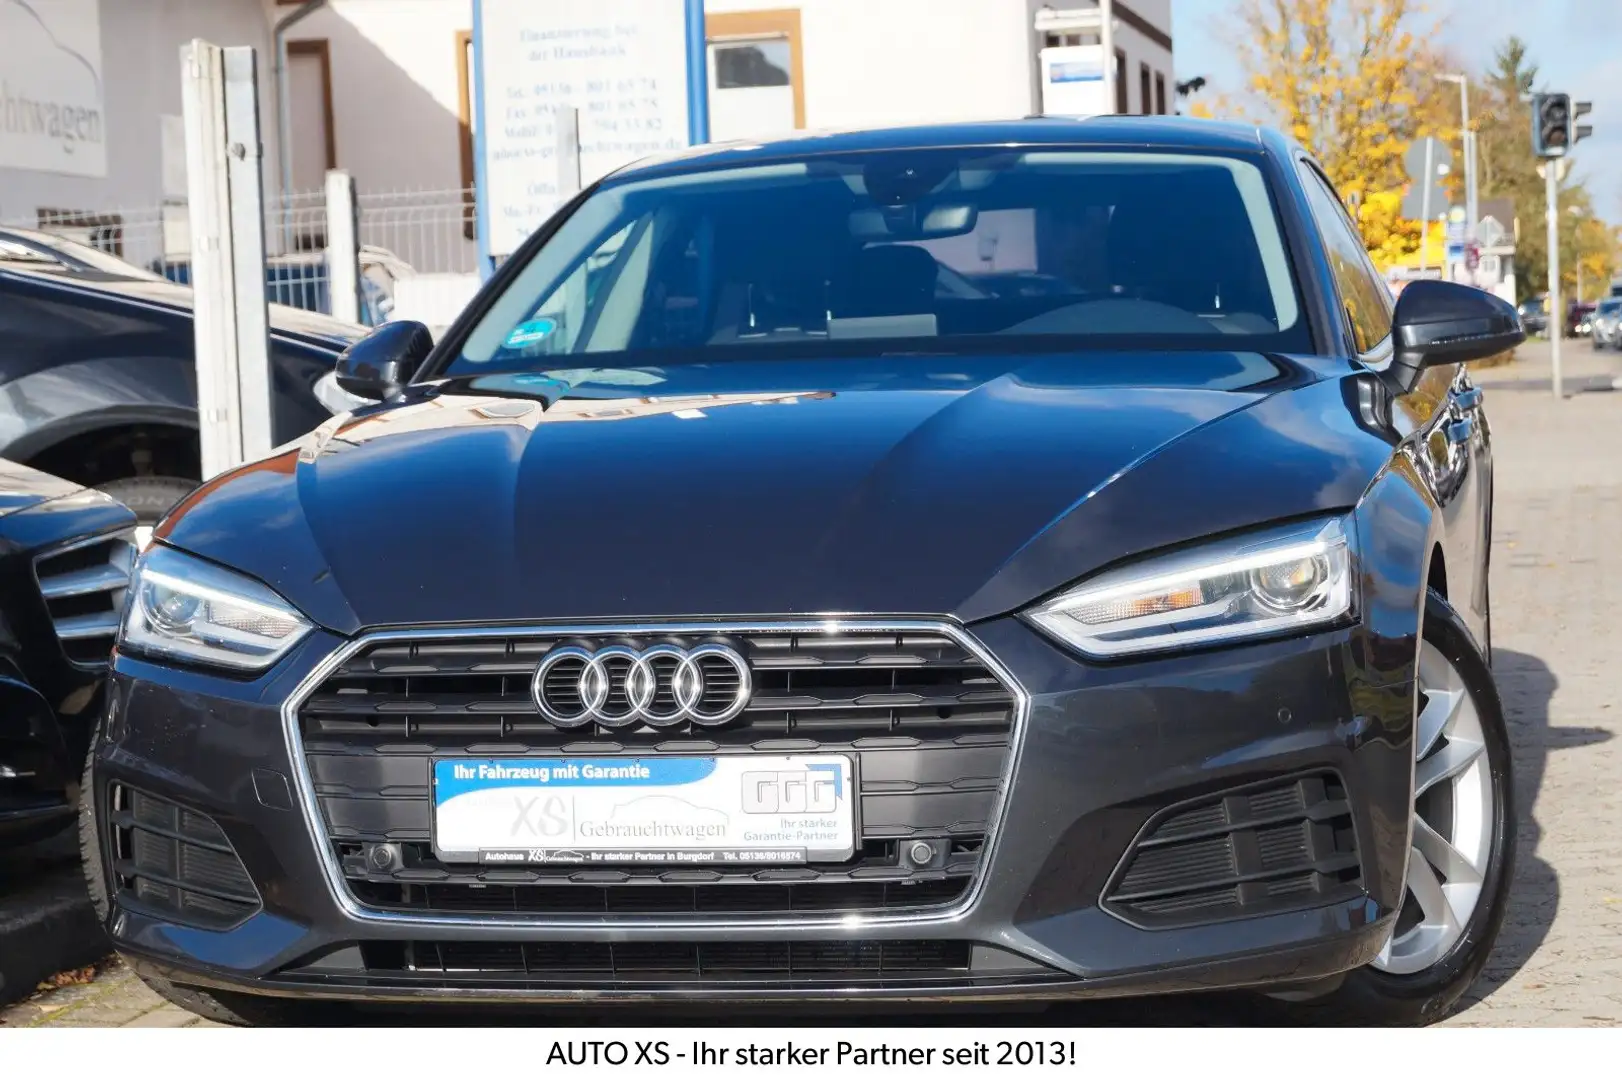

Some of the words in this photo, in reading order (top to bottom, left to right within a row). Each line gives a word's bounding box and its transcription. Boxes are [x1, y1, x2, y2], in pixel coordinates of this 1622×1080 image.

[453, 764, 476, 779] Ihr
[478, 764, 550, 783] Fahrzeug
[552, 764, 580, 779] mit
[581, 764, 650, 780] Garantie
[509, 795, 570, 838] XS
[579, 820, 727, 842] Gebrauchtwagen
[779, 817, 797, 829] Ihr
[798, 816, 838, 829] starker
[742, 829, 840, 843] Garantie-Partner
[485, 852, 525, 861] Autohaus
[591, 852, 604, 861] Ihr
[604, 852, 633, 861] starker
[634, 852, 666, 861] Partner
[666, 852, 675, 861] in
[676, 852, 715, 863] Burgdorf
[722, 852, 737, 861] Tel.
